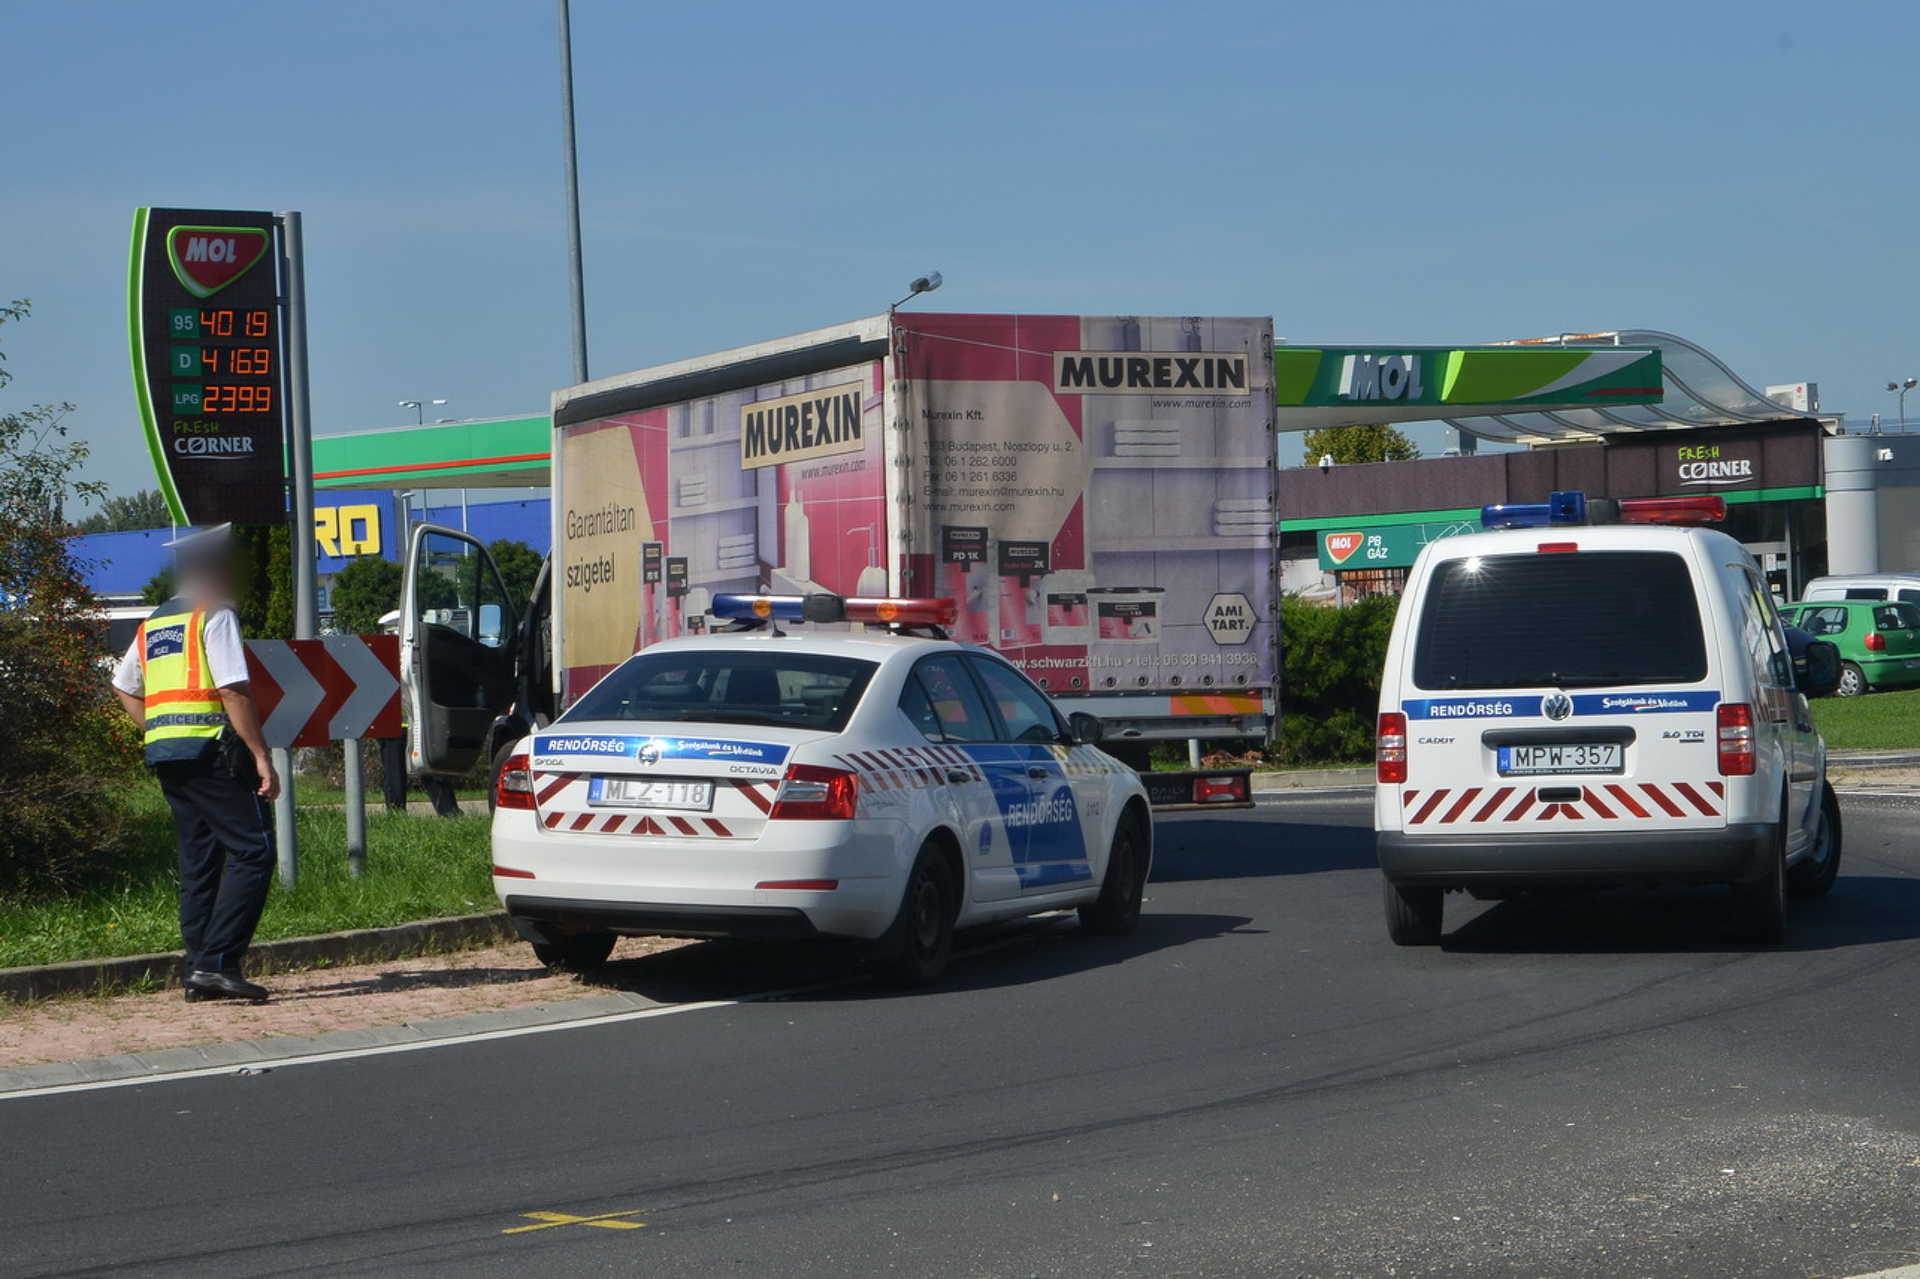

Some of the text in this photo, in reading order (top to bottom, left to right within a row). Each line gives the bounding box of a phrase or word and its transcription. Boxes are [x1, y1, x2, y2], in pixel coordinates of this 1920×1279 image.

[185, 237, 237, 263] MOL
[174, 315, 194, 330] 95
[179, 353, 192, 368] D
[1060, 357, 1246, 388] MUREXIN
[1338, 354, 1424, 400] MOL
[175, 393, 200, 405] LPG
[1152, 399, 1252, 410] www.murexin.com
[966, 409, 985, 421] Kft.
[173, 420, 220, 434] FRESH
[745, 391, 861, 459] MUREXIN
[174, 436, 254, 453] CORNER
[1678, 446, 1720, 460] FRESH
[992, 456, 1017, 467] 6000
[945, 471, 958, 482] 06
[1679, 460, 1753, 479] CORNER
[567, 501, 636, 541] Garantáltan
[1331, 537, 1352, 550] MOL
[1367, 535, 1382, 547] PB
[567, 551, 615, 593] szigetel
[1215, 605, 1243, 617] AMI
[1211, 619, 1250, 631] TART.
[1430, 701, 1513, 717] RENDŐRSÉG
[548, 737, 625, 753] RENDŐRSÉG
[1418, 737, 1456, 745] CADDY
[1515, 746, 1615, 767] MPW-357
[730, 765, 779, 776] OCTAVIA
[606, 778, 706, 804] MLZ-118
[1008, 793, 1072, 827] RENDŐRSÉG
